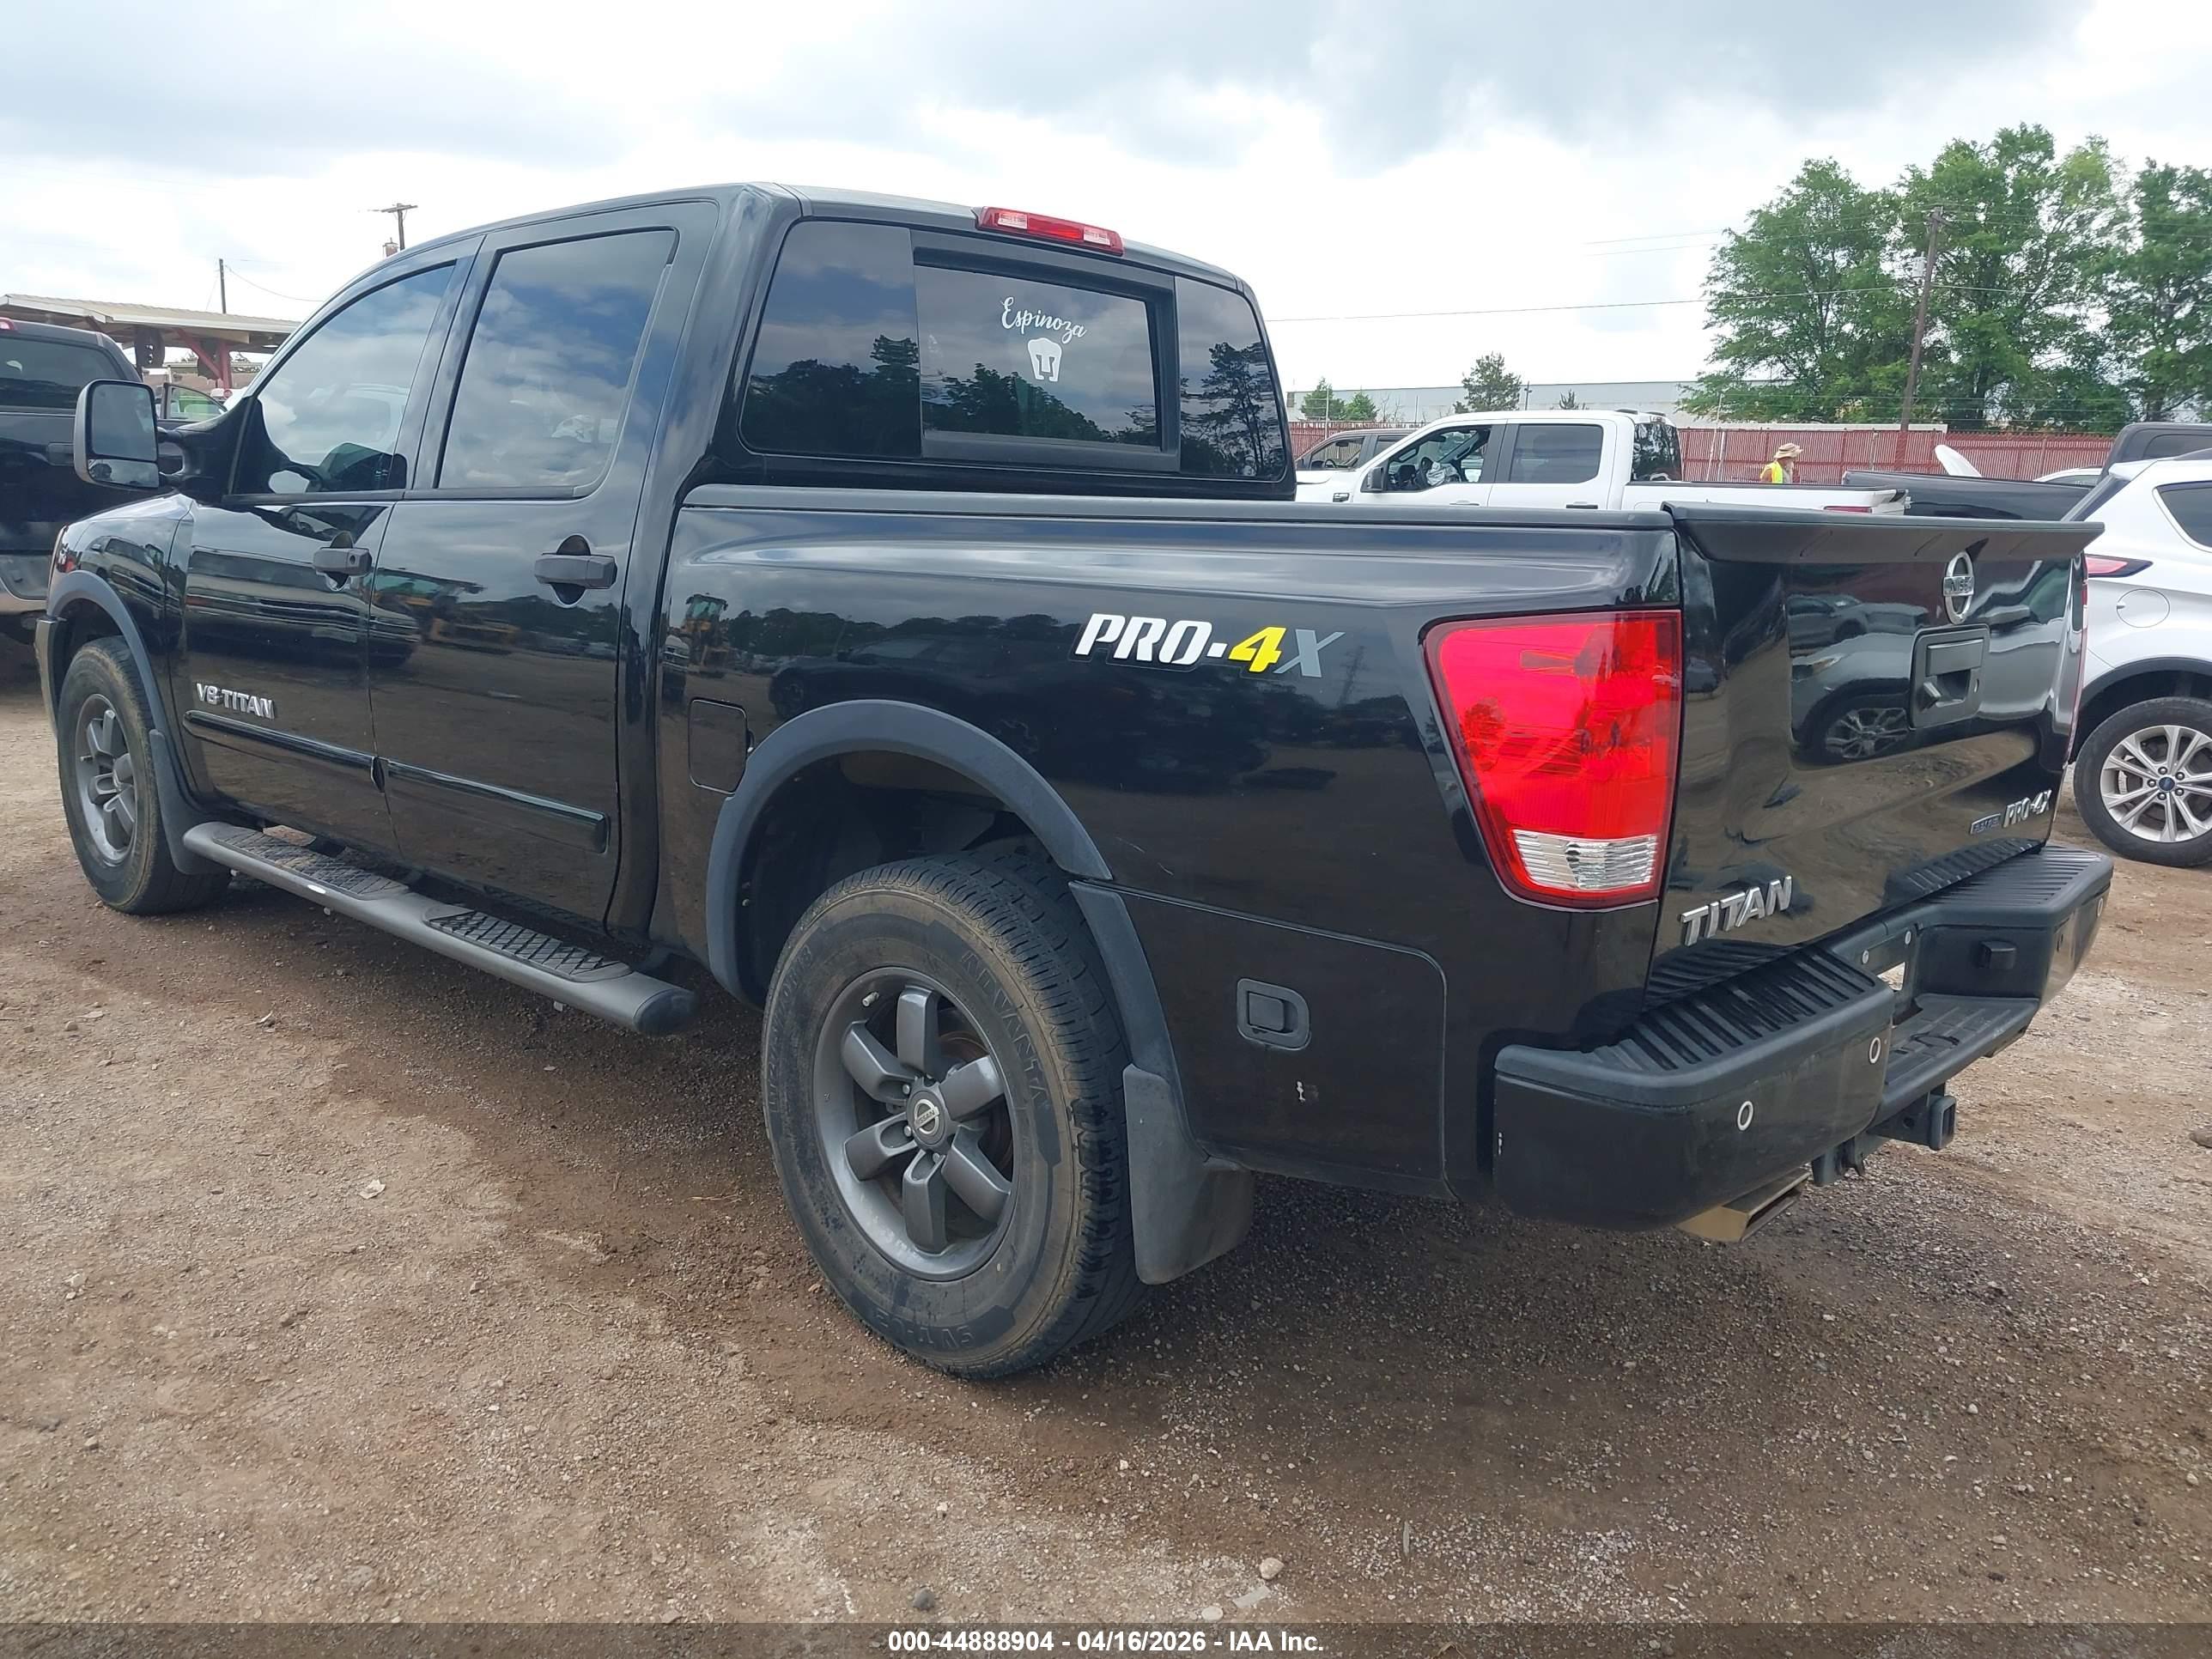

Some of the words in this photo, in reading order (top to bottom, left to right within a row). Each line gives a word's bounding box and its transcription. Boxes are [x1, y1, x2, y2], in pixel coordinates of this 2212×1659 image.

[1000, 296, 1087, 344] Espinoza
[1074, 613, 1346, 678] PRO-4X
[1680, 875, 1792, 946] TITAN
